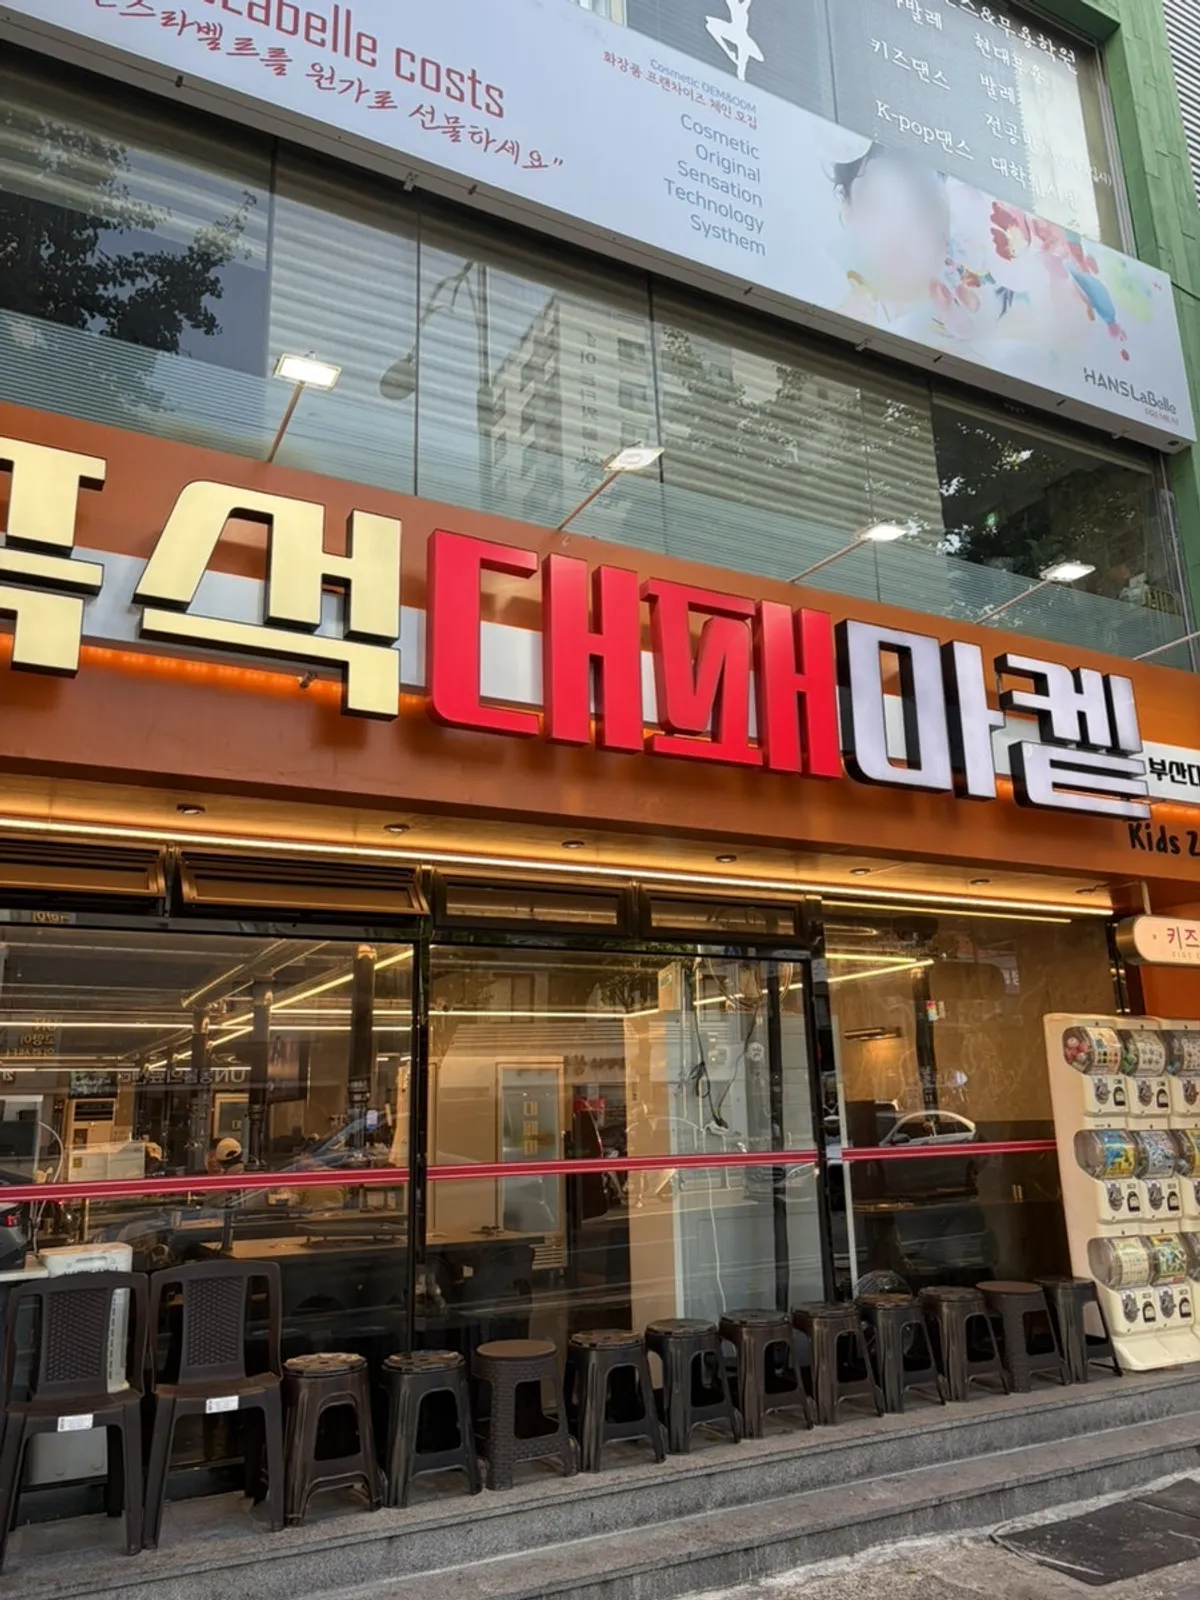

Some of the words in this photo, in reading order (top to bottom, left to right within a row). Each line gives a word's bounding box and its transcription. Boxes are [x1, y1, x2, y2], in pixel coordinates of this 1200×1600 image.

[651, 58, 700, 89] Cosmetic
[870, 38, 951, 90] 키즈댄스
[973, 32, 1045, 84] 현대무용
[305, 62, 398, 110] 원가로
[395, 47, 504, 118] costs
[603, 51, 643, 80] 화장품
[734, 111, 759, 131] 모집
[979, 72, 1016, 105] 발레
[680, 113, 760, 160] Cosmetic
[875, 99, 975, 161] K-pop댄스
[677, 160, 763, 208] Sensation
[695, 143, 761, 185] Original
[663, 177, 765, 235] Technology
[690, 213, 766, 256] Systhem
[1083, 366, 1178, 415] HANSLaBelle
[1128, 822, 1181, 855] Kids
[1166, 926, 1200, 951] 키즈
